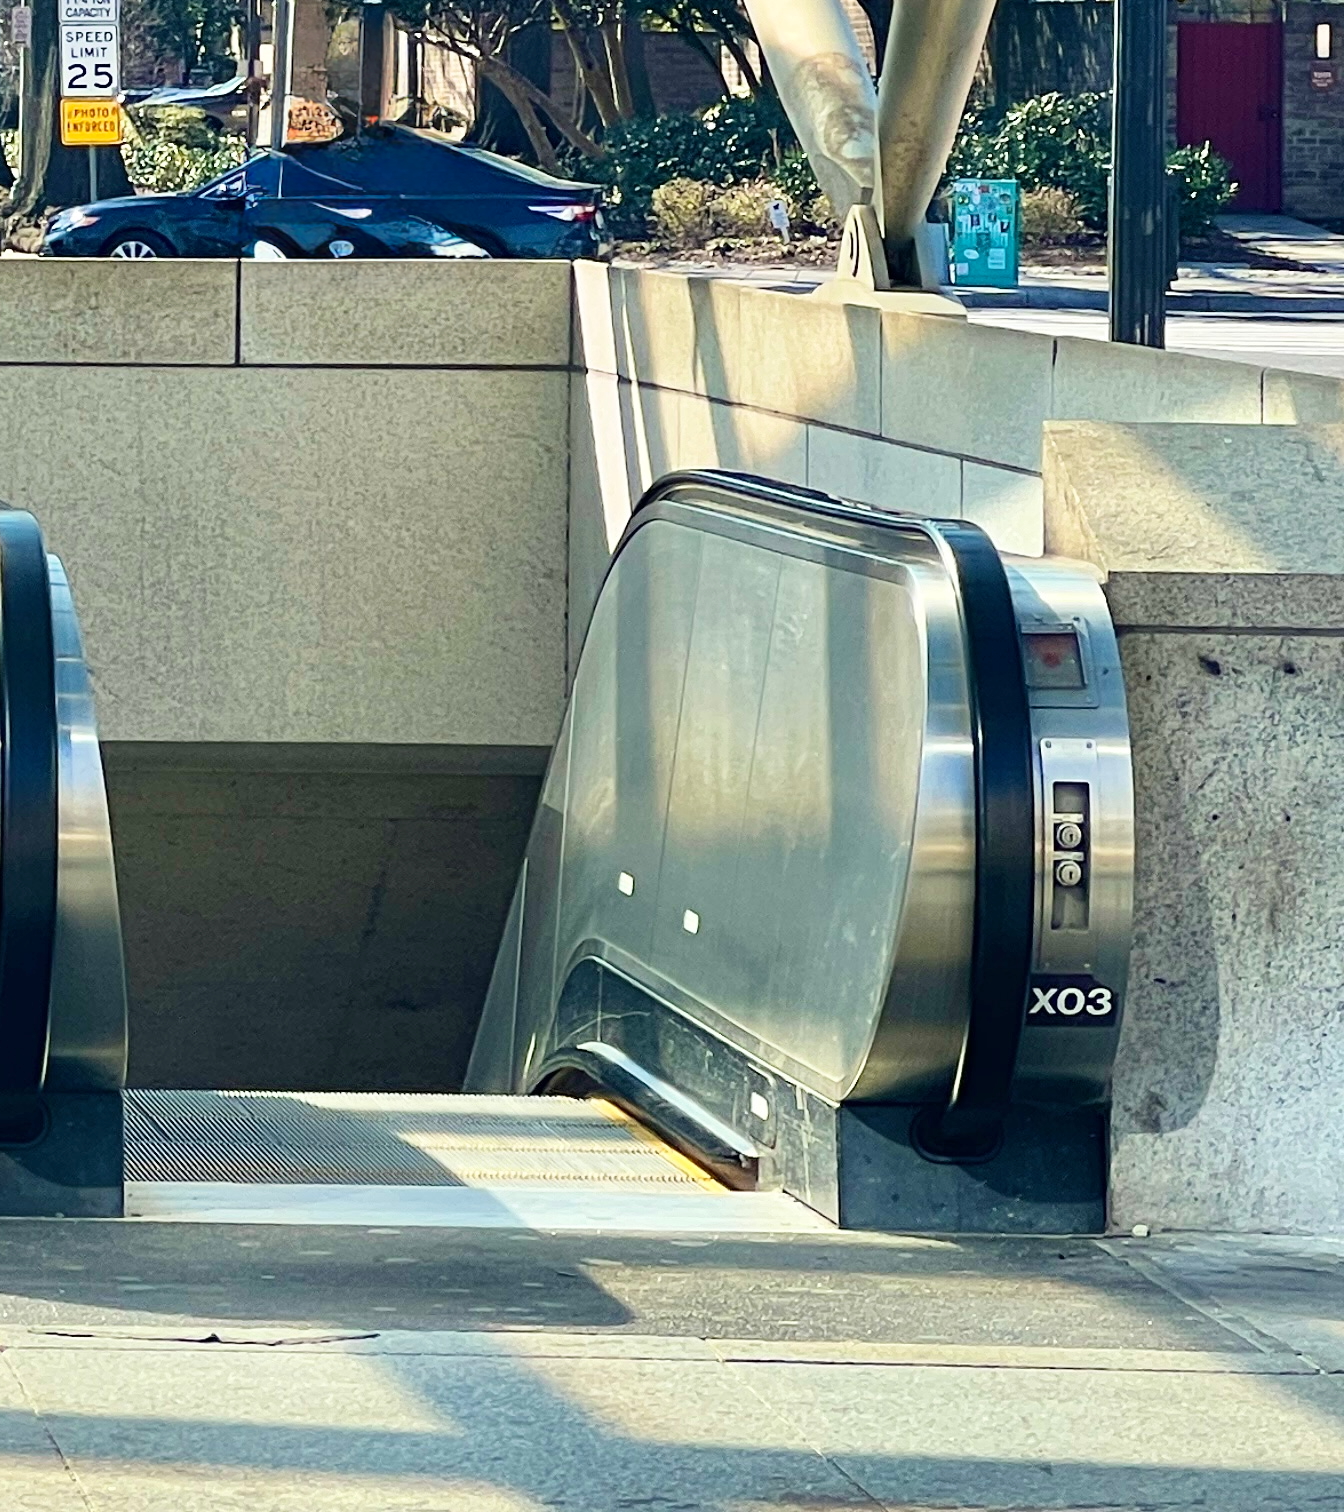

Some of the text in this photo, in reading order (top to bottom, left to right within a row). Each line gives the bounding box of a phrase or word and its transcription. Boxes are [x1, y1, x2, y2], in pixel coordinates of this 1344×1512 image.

[65, 7, 111, 18] CAPACITY
[66, 31, 113, 43] SPEED
[71, 47, 108, 58] LIMIT
[68, 63, 113, 89] 25
[74, 108, 109, 118] PHOTO
[67, 120, 115, 133] ENFORCED
